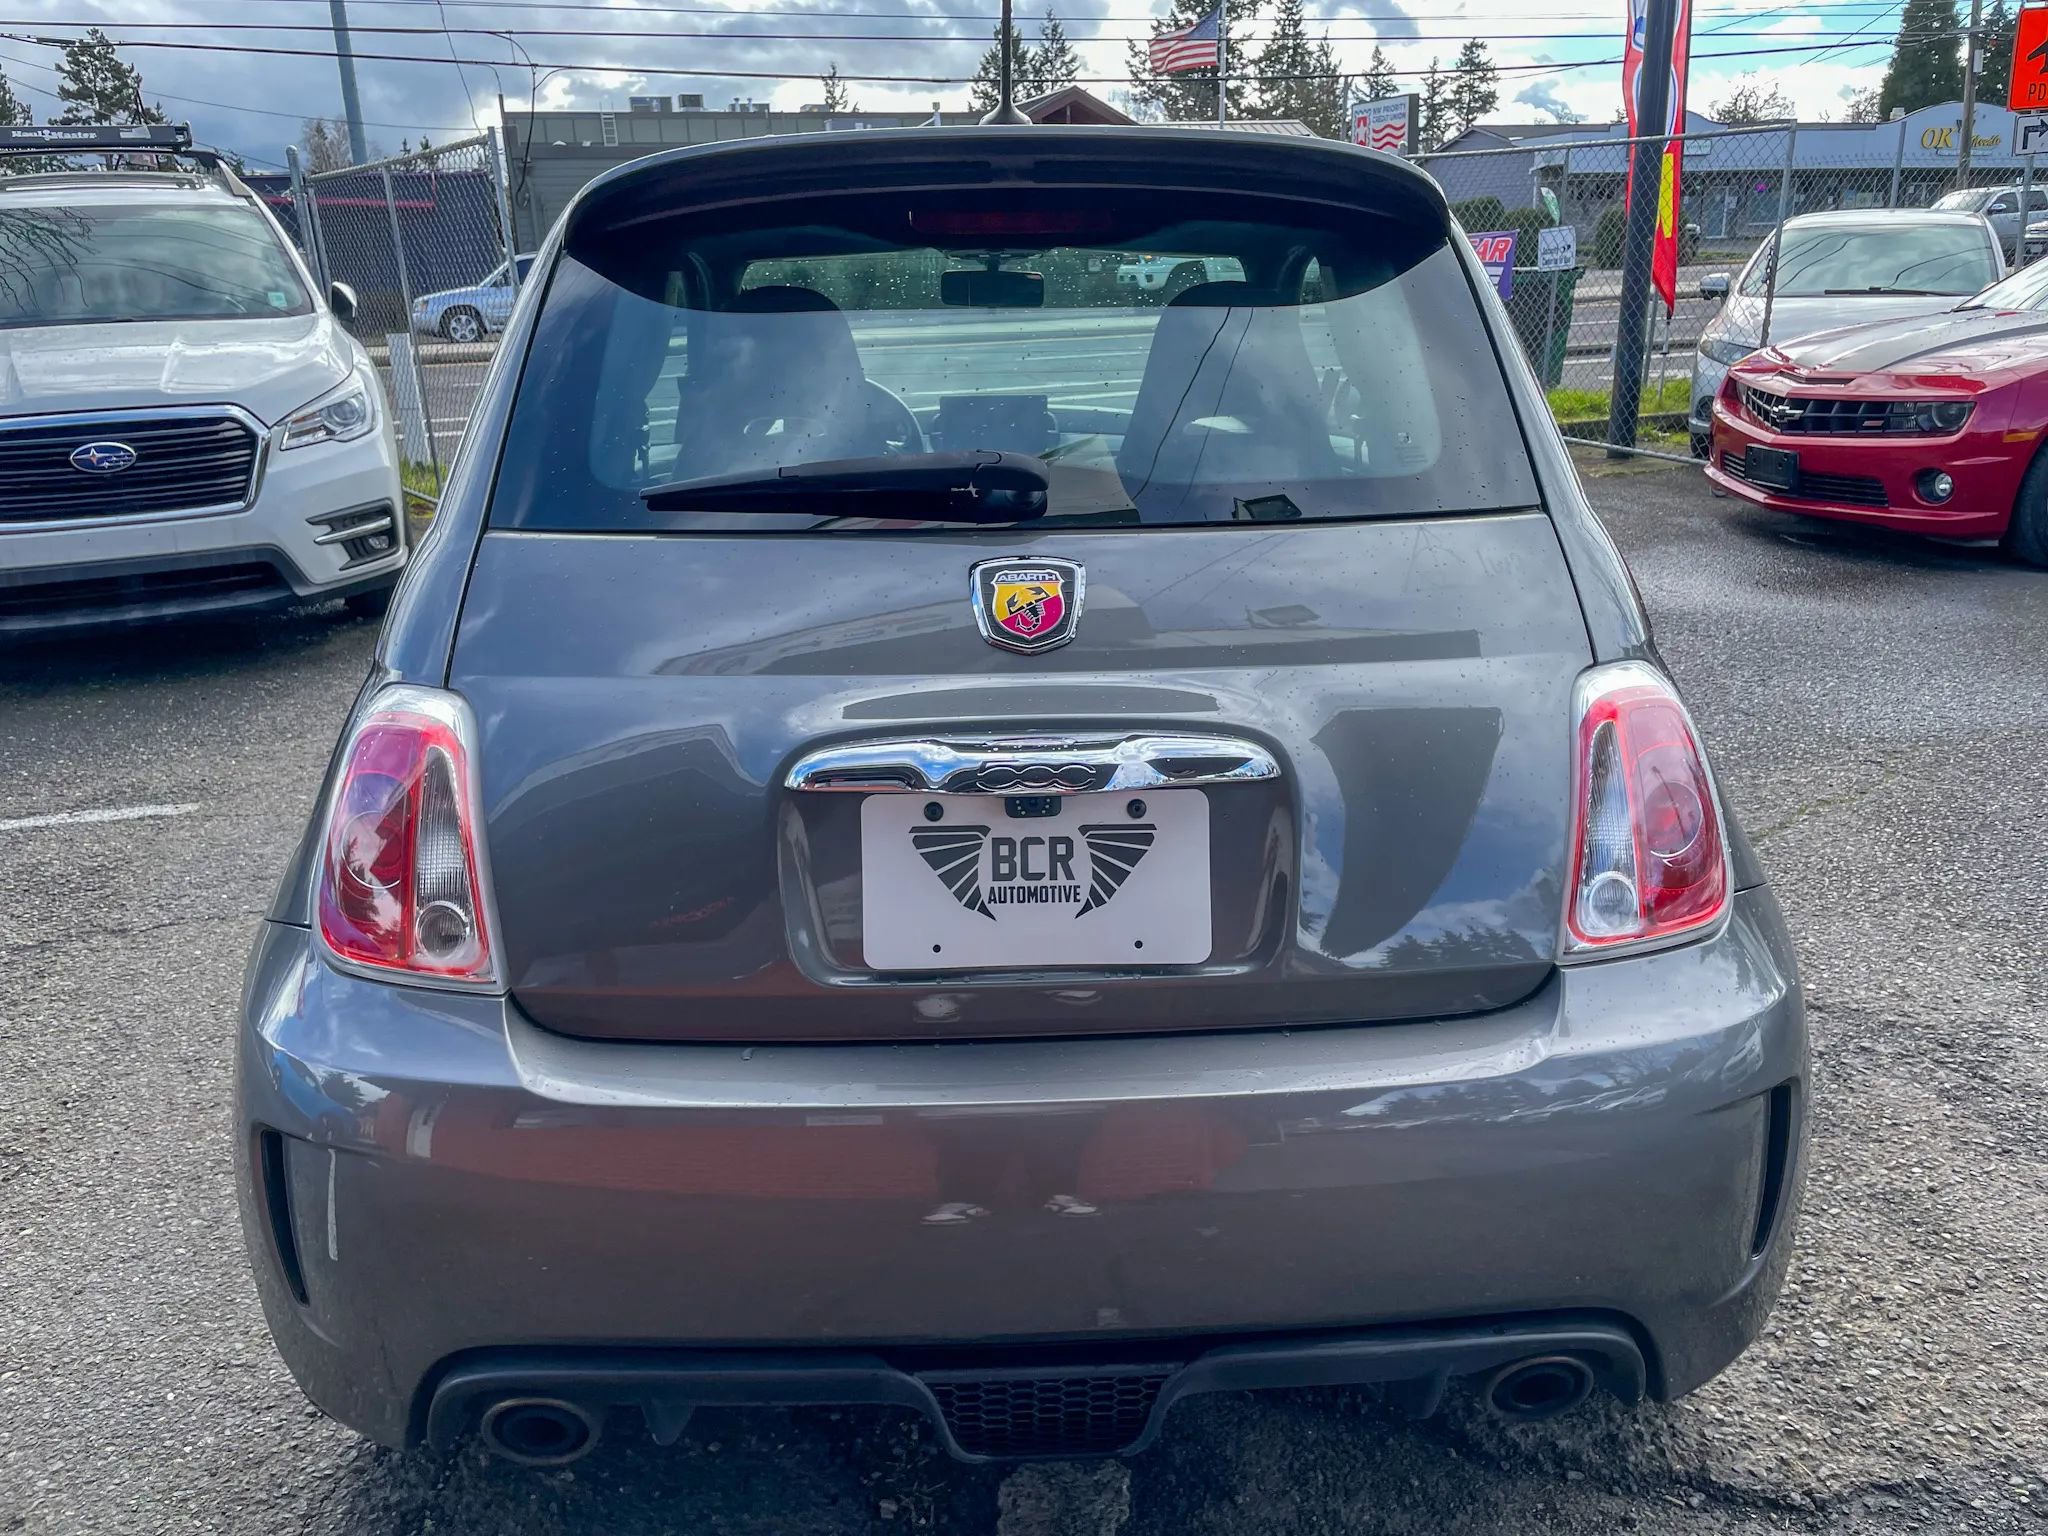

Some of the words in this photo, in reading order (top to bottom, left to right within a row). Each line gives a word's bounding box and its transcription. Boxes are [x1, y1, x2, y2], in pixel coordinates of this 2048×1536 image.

[998, 573, 1056, 582] ABARTH
[991, 836, 1076, 882] BCR
[987, 885, 1081, 905] AUTOMOTIVE
